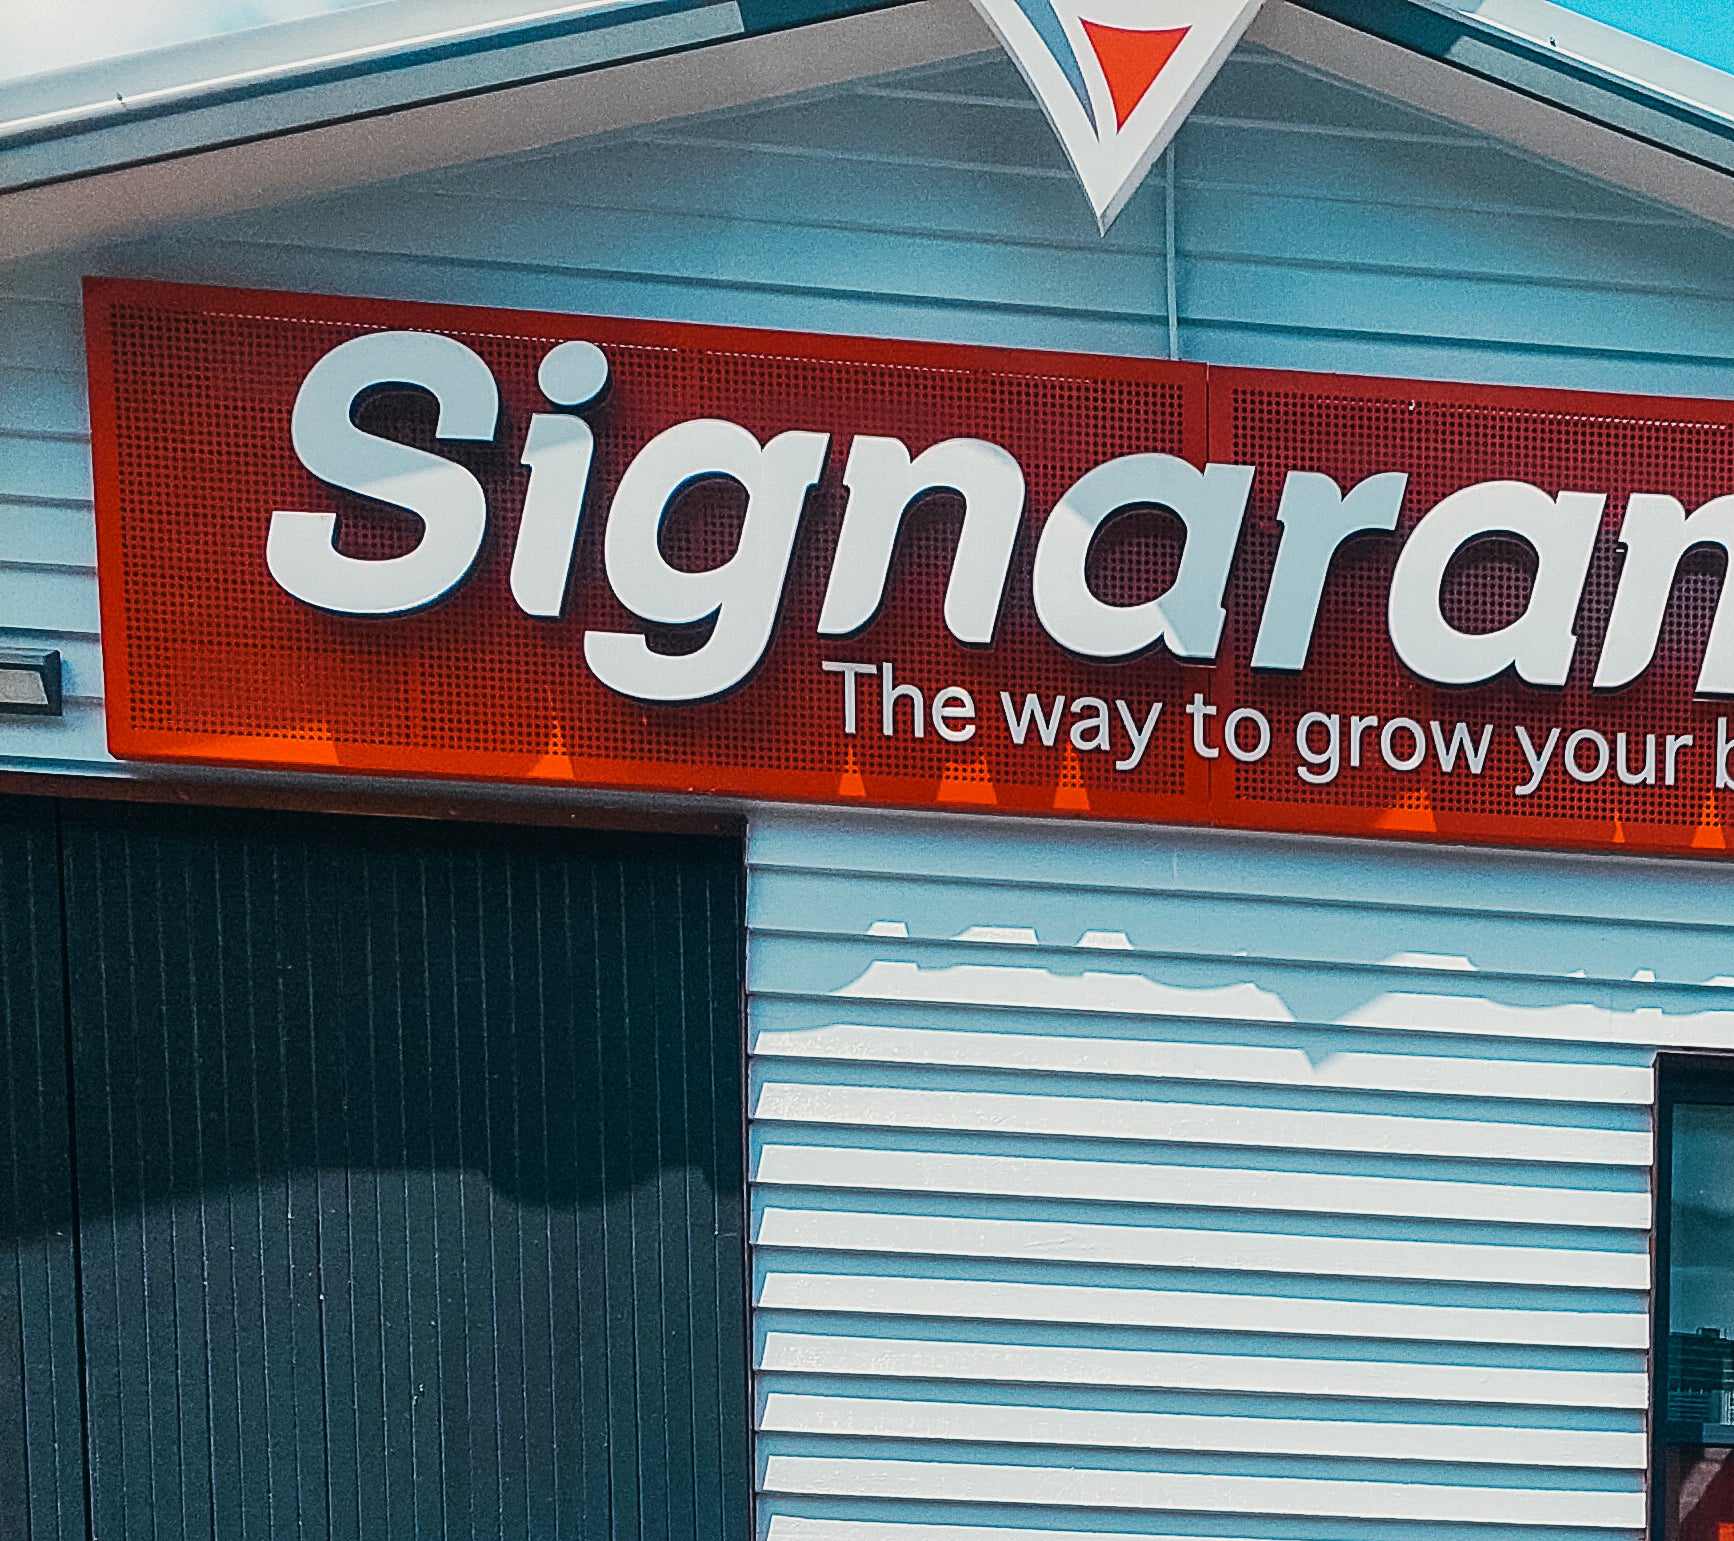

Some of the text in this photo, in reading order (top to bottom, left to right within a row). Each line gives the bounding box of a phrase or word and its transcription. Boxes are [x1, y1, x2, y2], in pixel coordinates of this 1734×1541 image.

[822, 660, 976, 742] The
[1000, 687, 1162, 771] way
[1185, 692, 1270, 761] to
[1295, 711, 1494, 783] grow
[1513, 724, 1694, 795] your
